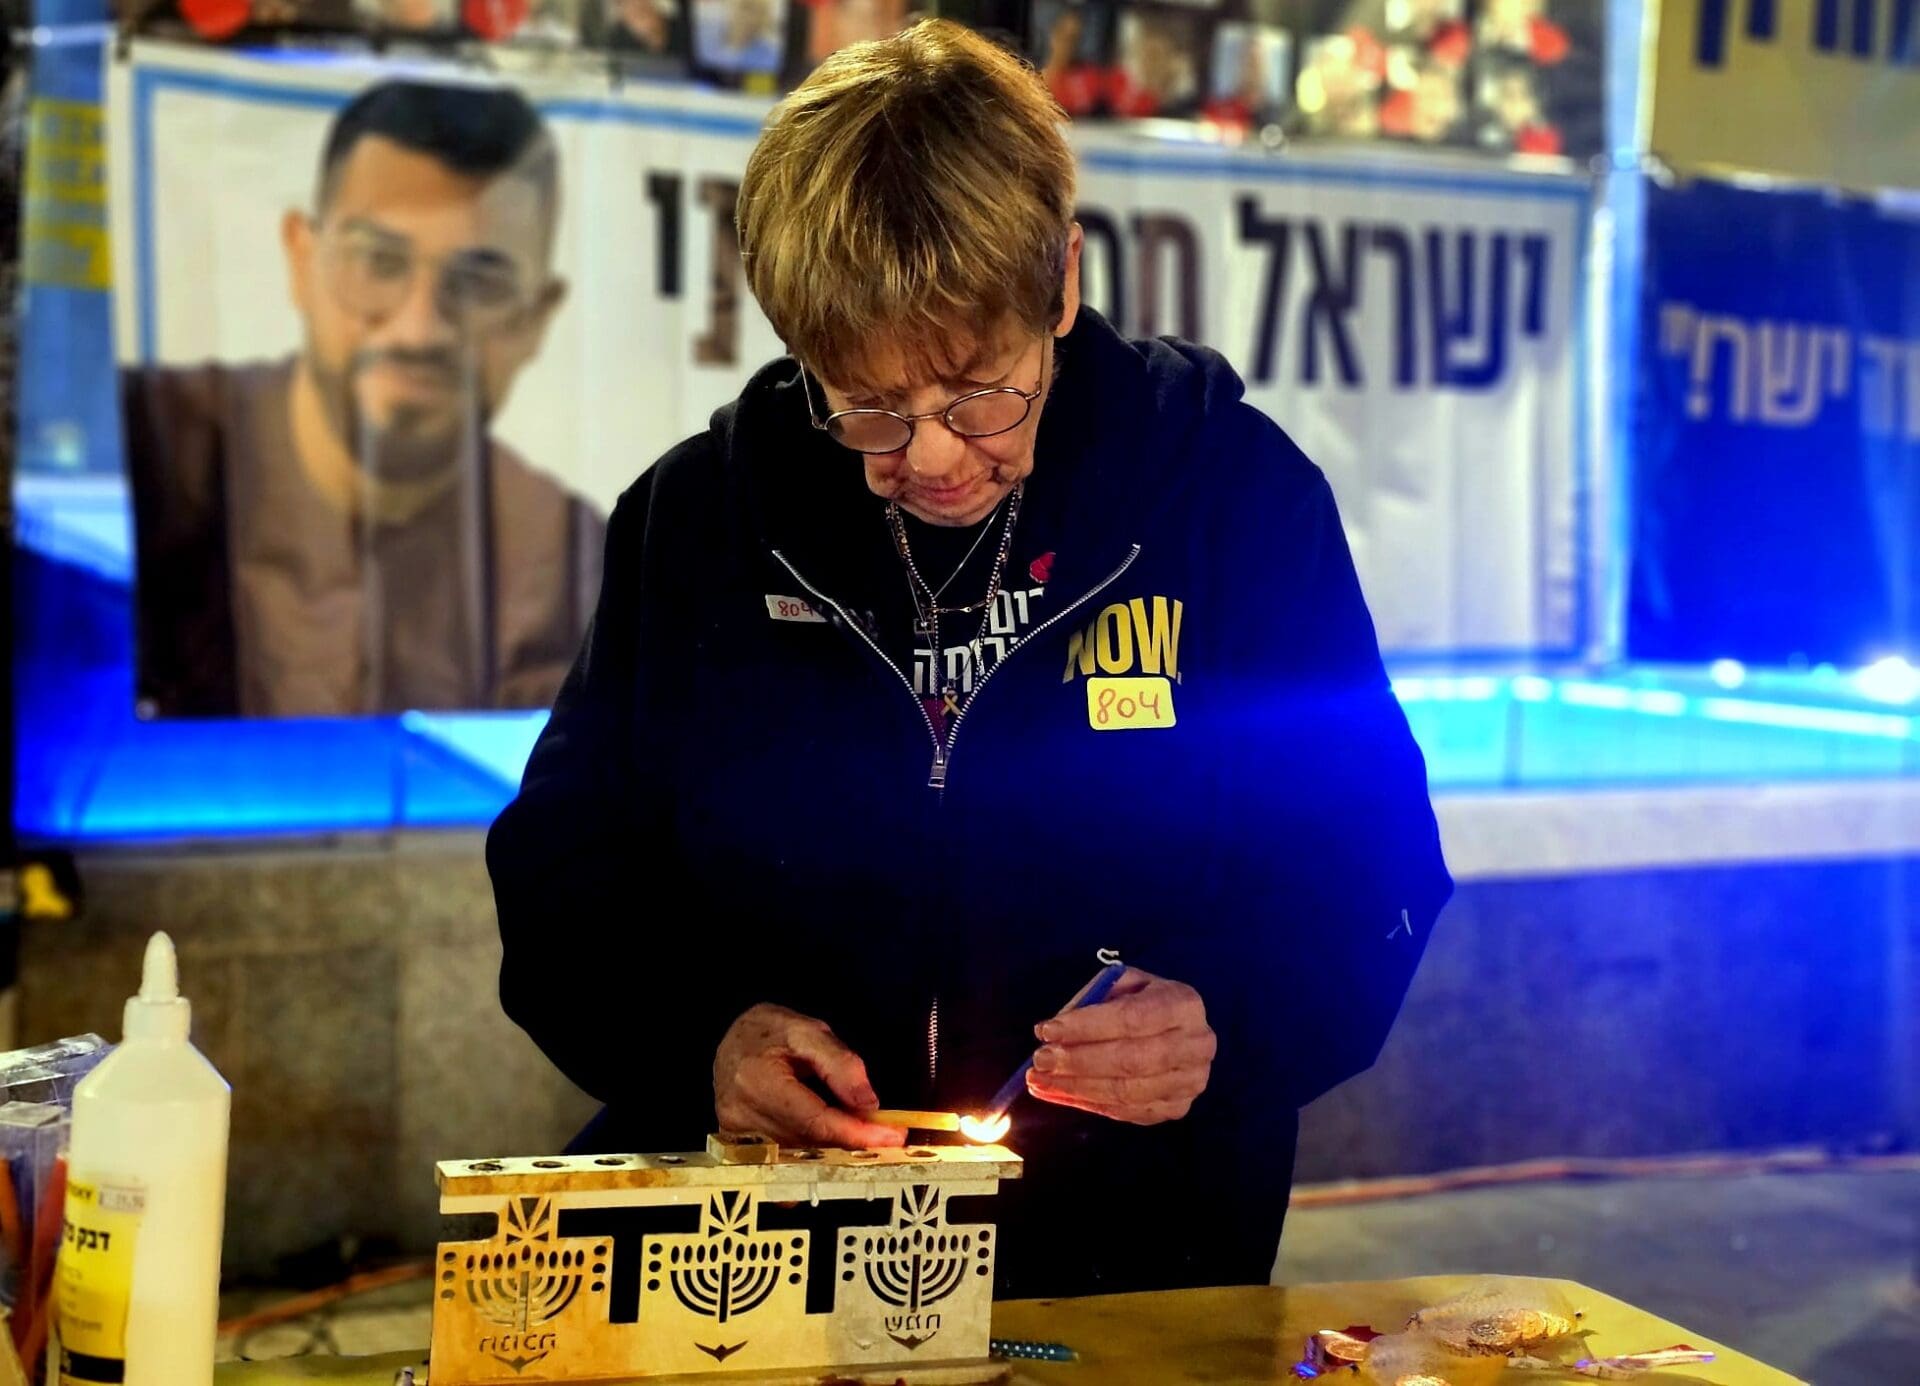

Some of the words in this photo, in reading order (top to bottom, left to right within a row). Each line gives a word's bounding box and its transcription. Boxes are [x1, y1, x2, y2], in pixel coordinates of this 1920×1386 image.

[1236, 194, 1552, 392] ישראל
[777, 600, 815, 618] 804
[1062, 595, 1184, 685] NOW
[1096, 687, 1161, 725] 804
[76, 1226, 111, 1253] דבק
